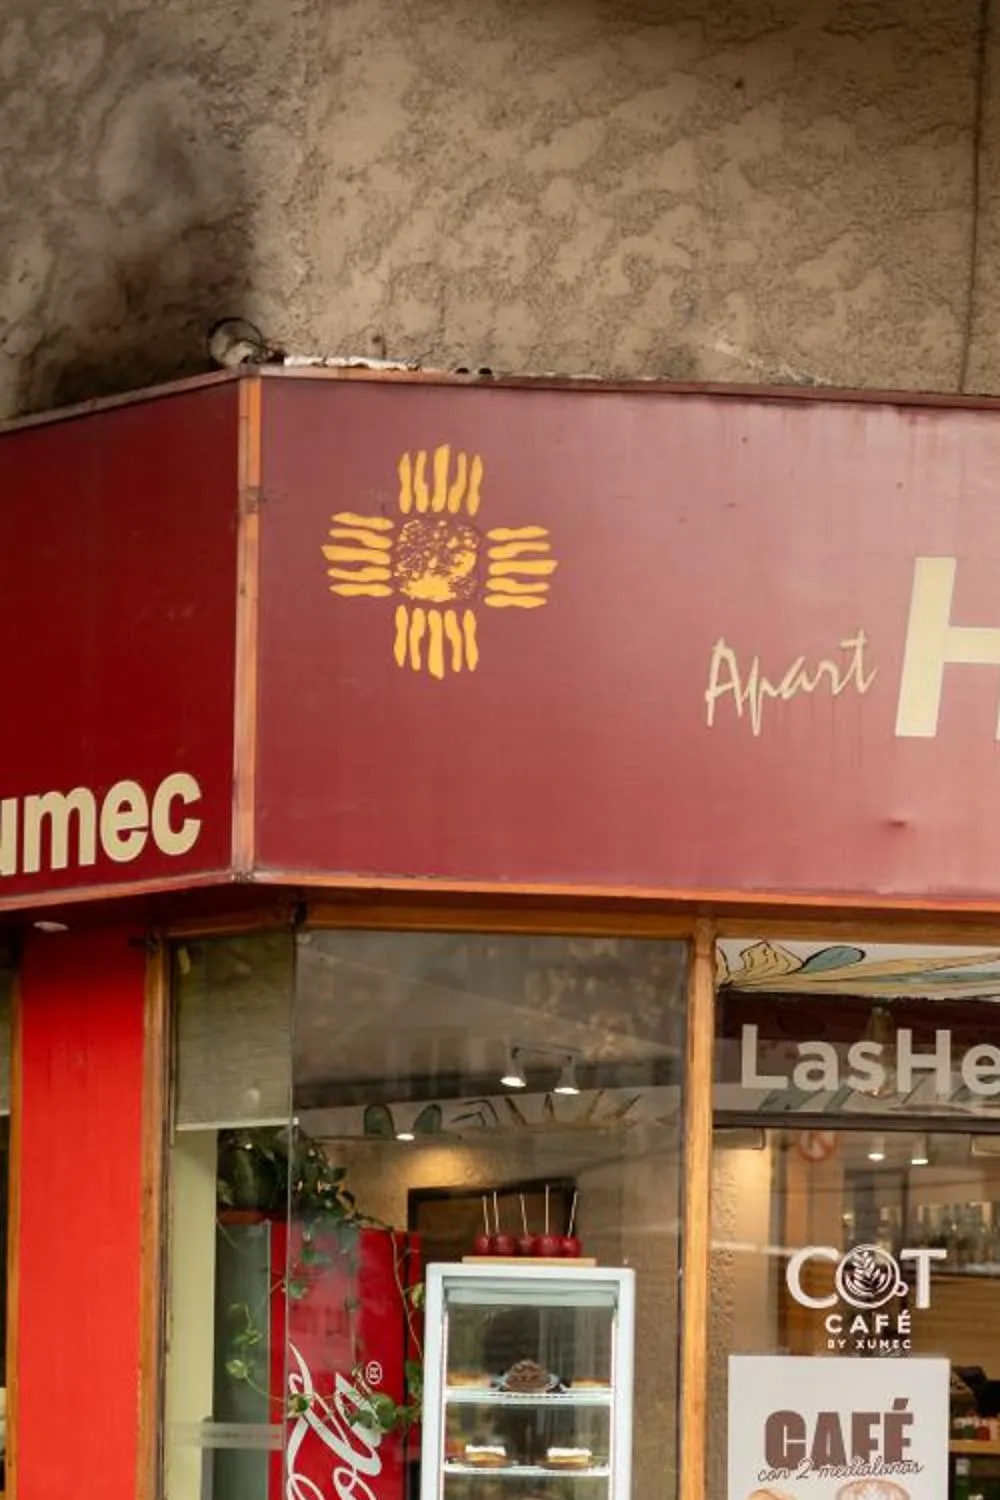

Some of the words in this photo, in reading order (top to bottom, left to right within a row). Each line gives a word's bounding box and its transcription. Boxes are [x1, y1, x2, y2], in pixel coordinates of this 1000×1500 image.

[704, 628, 877, 736] Apart
[825, 1309, 911, 1334] CAFÉ
[827, 1339, 847, 1350] BY
[764, 1397, 914, 1471] CAFÉ
[757, 1467, 791, 1482] con
[796, 1457, 814, 1481] 2
